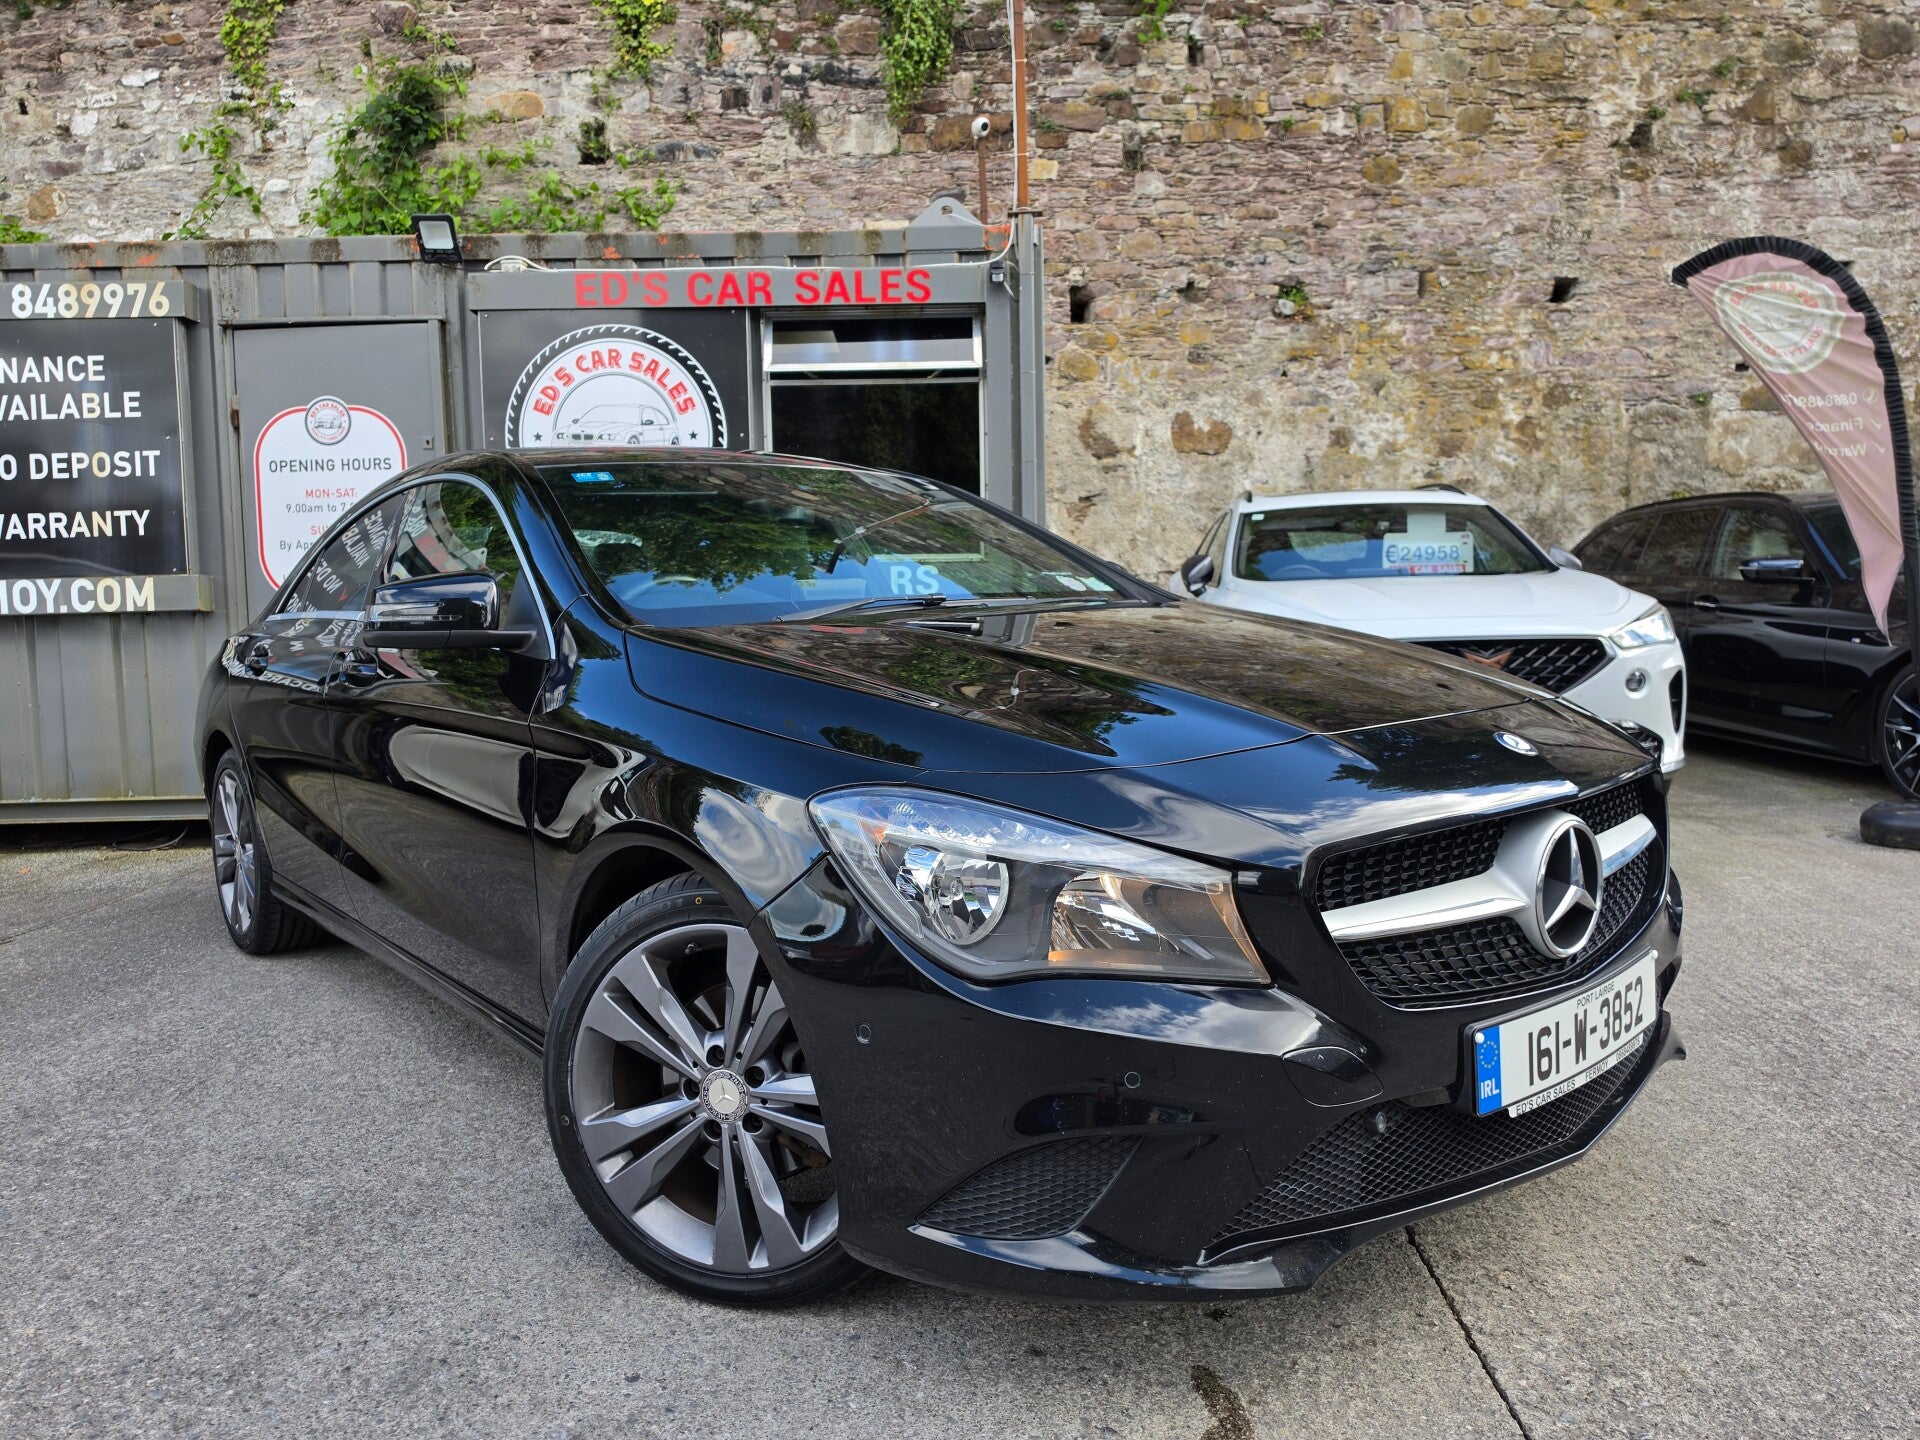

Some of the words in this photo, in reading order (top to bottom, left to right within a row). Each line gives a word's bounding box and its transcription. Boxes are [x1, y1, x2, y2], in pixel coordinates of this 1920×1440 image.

[11, 281, 170, 319] 8489976
[574, 271, 670, 308] ED'S
[687, 270, 773, 305] CAR
[794, 269, 933, 304] SALES
[0, 354, 106, 384] NANCE
[533, 366, 575, 416] ED'S
[575, 349, 623, 374] CAR
[628, 351, 697, 416] SALES
[29, 450, 161, 481] DEPOSIT
[268, 459, 336, 473] OPENING
[341, 457, 393, 471] HOURS
[286, 503, 324, 514] 9.00am
[327, 503, 337, 513] to
[0, 509, 150, 540] ARRANTY
[279, 540, 293, 554] By
[1385, 544, 1460, 564] €24958
[889, 564, 940, 595] RS
[1576, 992, 1594, 1009] PORT
[1527, 975, 1643, 1087] 161-W-3852
[1479, 1077, 1500, 1100] IRL
[1516, 1100, 1534, 1116] ED'S
[1535, 1092, 1552, 1107] CAR
[1553, 1079, 1576, 1098] SALES
[1585, 1059, 1609, 1081] FERMOY
